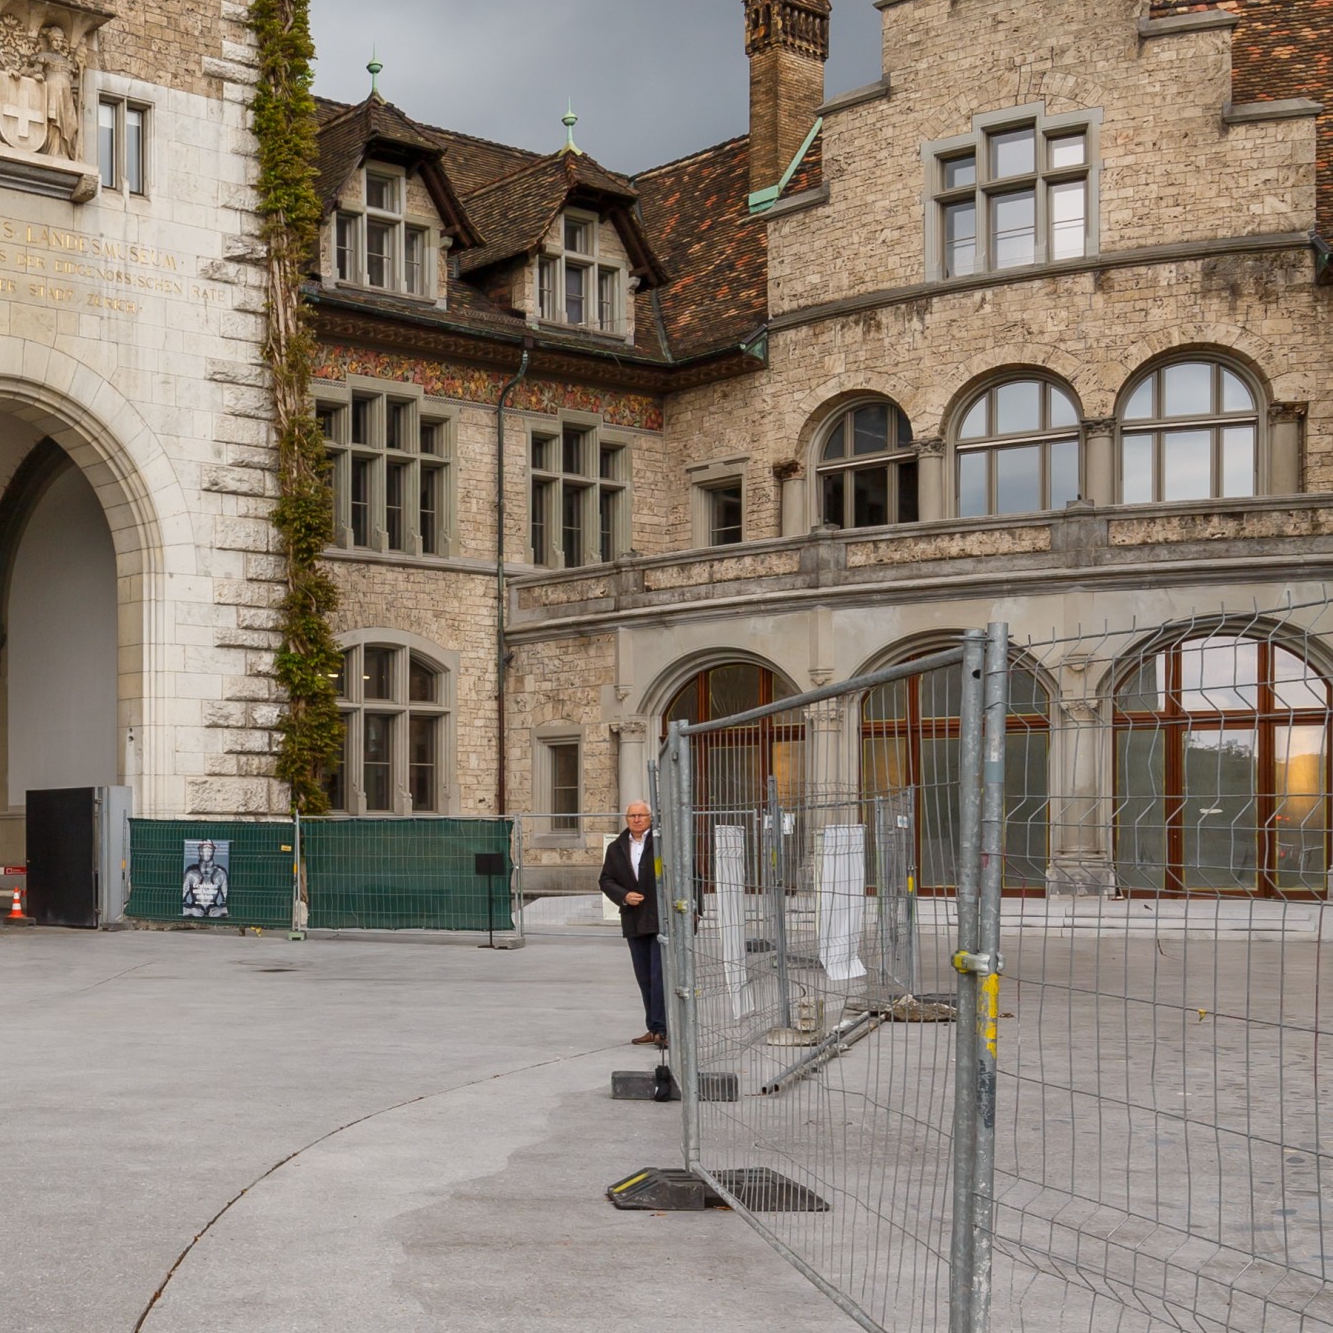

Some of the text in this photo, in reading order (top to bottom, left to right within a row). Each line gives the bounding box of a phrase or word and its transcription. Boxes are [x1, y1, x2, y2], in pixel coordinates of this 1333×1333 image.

[27, 225, 178, 270] LANDESMUSEUM
[17, 252, 46, 270] DER
[29, 283, 74, 302] STADT
